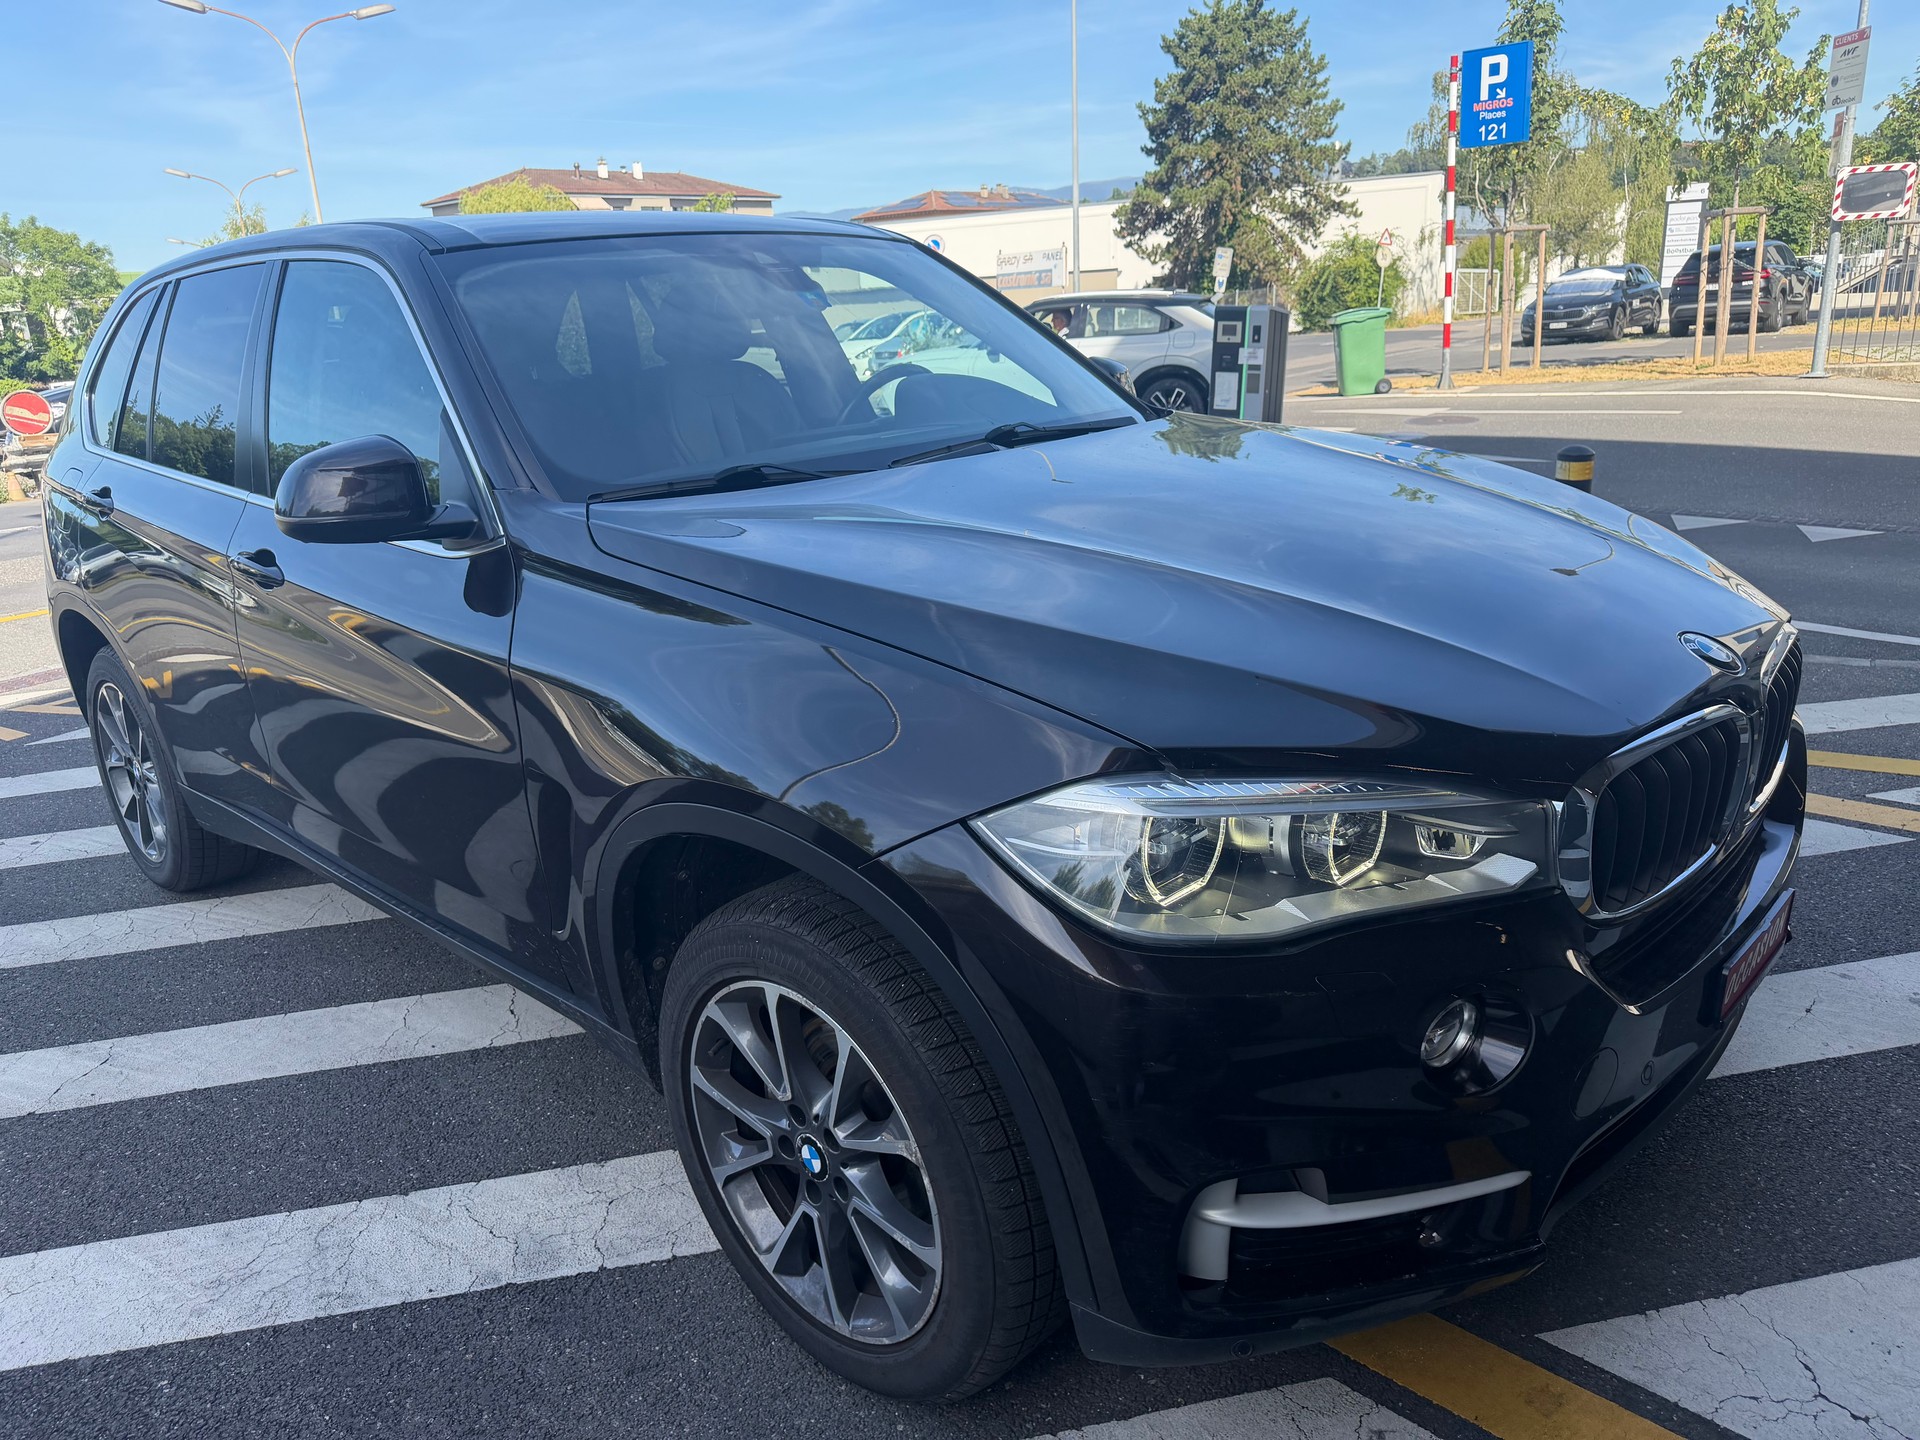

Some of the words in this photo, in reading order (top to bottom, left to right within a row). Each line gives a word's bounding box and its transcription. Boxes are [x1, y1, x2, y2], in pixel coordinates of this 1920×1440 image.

[1836, 32, 1859, 46] CLIENTS
[1480, 53, 1508, 102] P
[1473, 97, 1513, 112] MIGROS
[1479, 110, 1506, 120] Places
[1479, 122, 1506, 141] 121
[1724, 904, 1790, 1005] OCCASION
